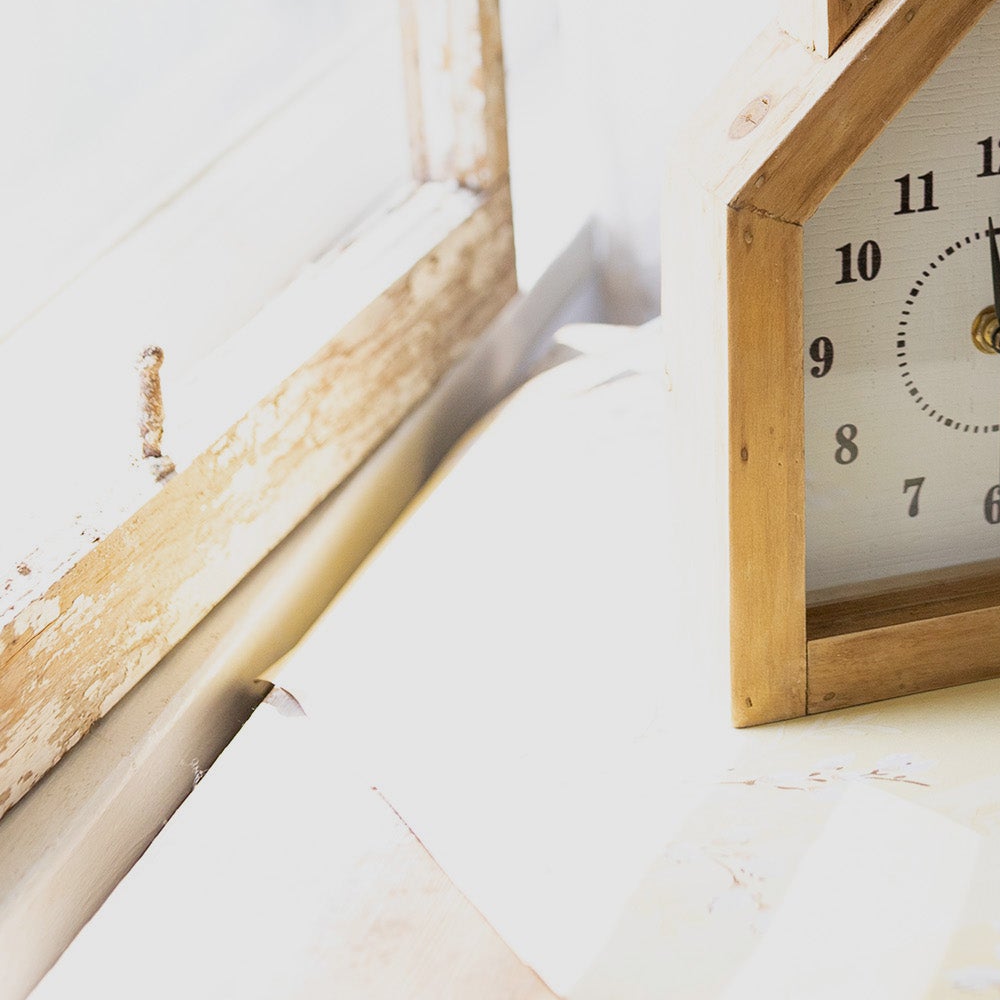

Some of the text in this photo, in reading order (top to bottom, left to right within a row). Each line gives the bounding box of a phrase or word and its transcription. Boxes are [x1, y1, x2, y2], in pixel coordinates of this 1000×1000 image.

[893, 170, 940, 216] 11
[834, 239, 882, 285] 10
[808, 336, 835, 379] 9
[834, 423, 859, 466] 8
[902, 476, 926, 518] 7
